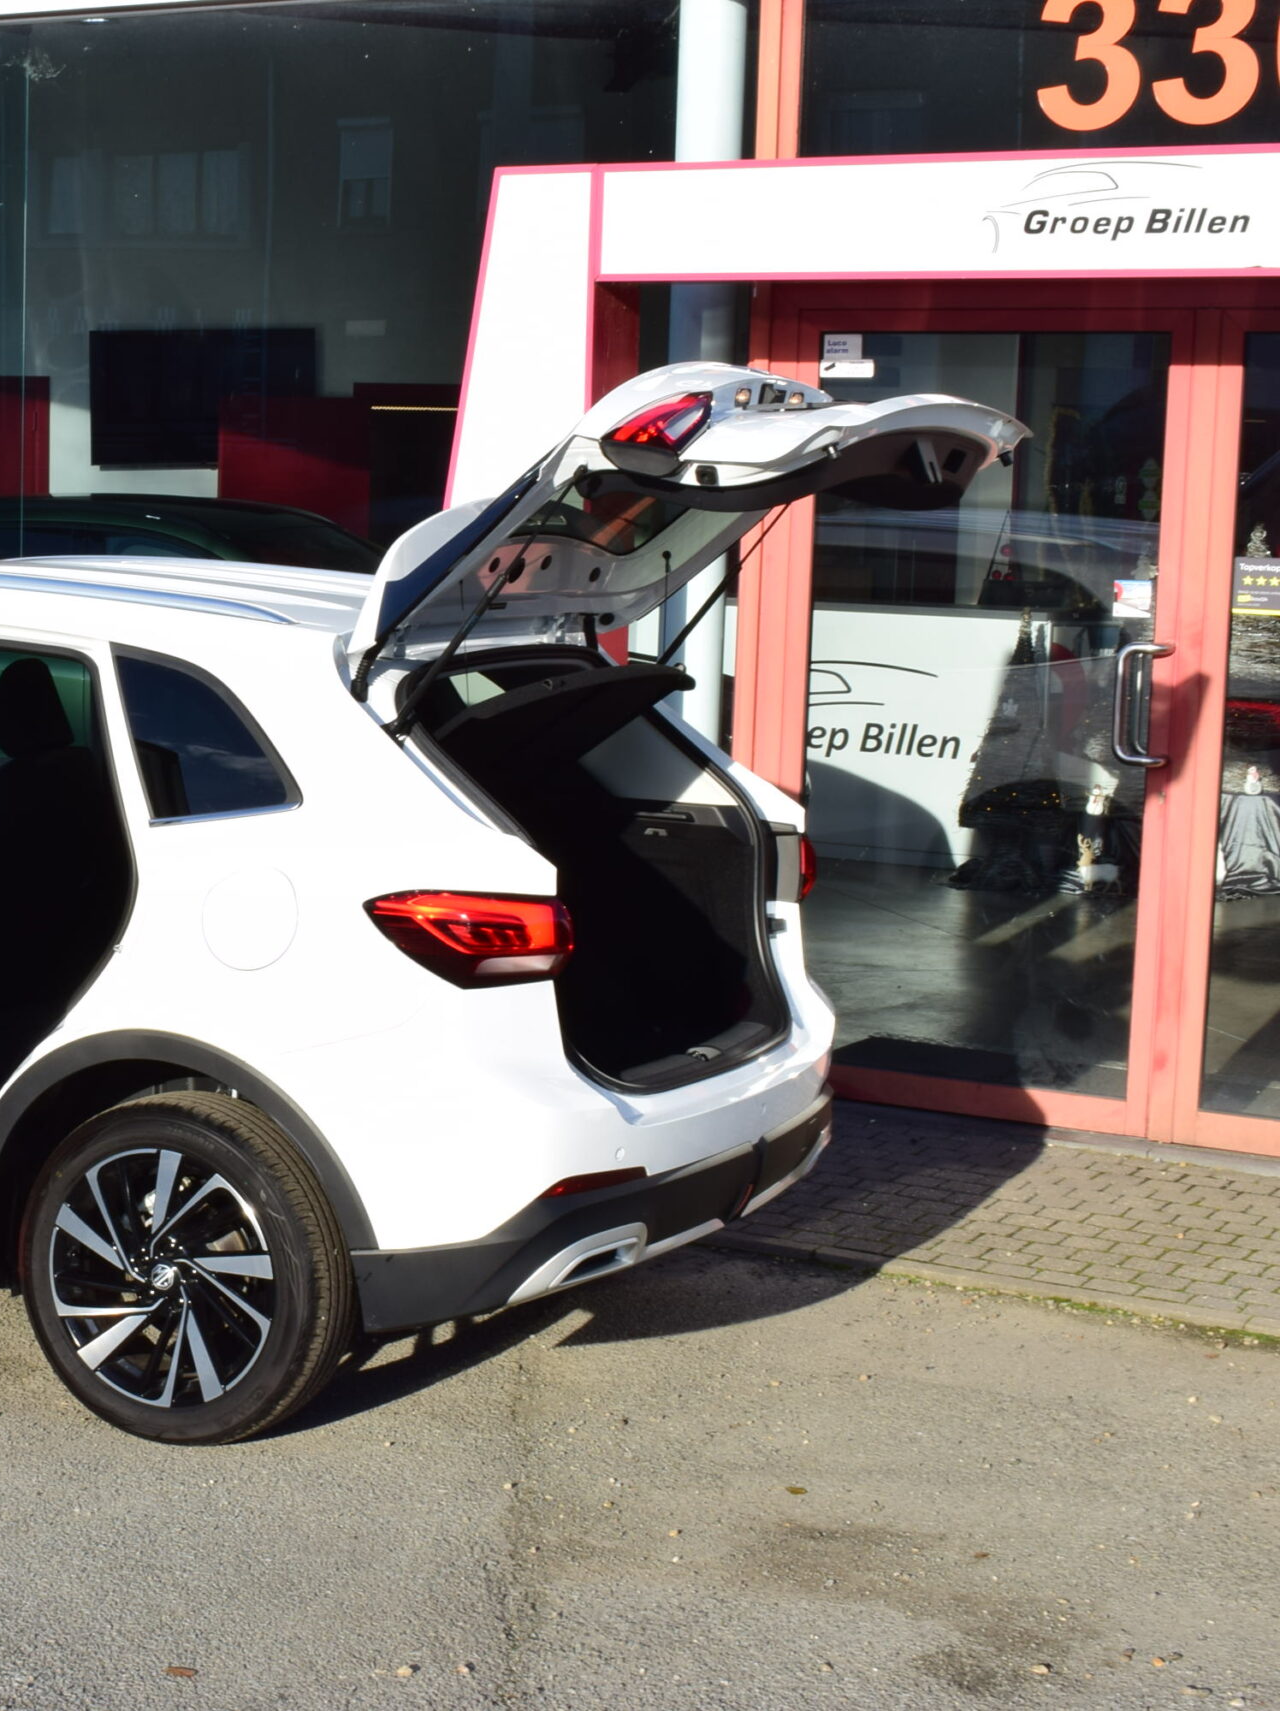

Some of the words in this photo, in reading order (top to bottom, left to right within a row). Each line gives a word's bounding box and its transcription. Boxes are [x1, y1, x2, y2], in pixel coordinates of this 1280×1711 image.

[1036, 0, 1280, 131] 33
[1023, 209, 1134, 241] Groep
[1145, 207, 1250, 234] Billen
[807, 726, 849, 758] ep
[859, 722, 961, 760] Billen
